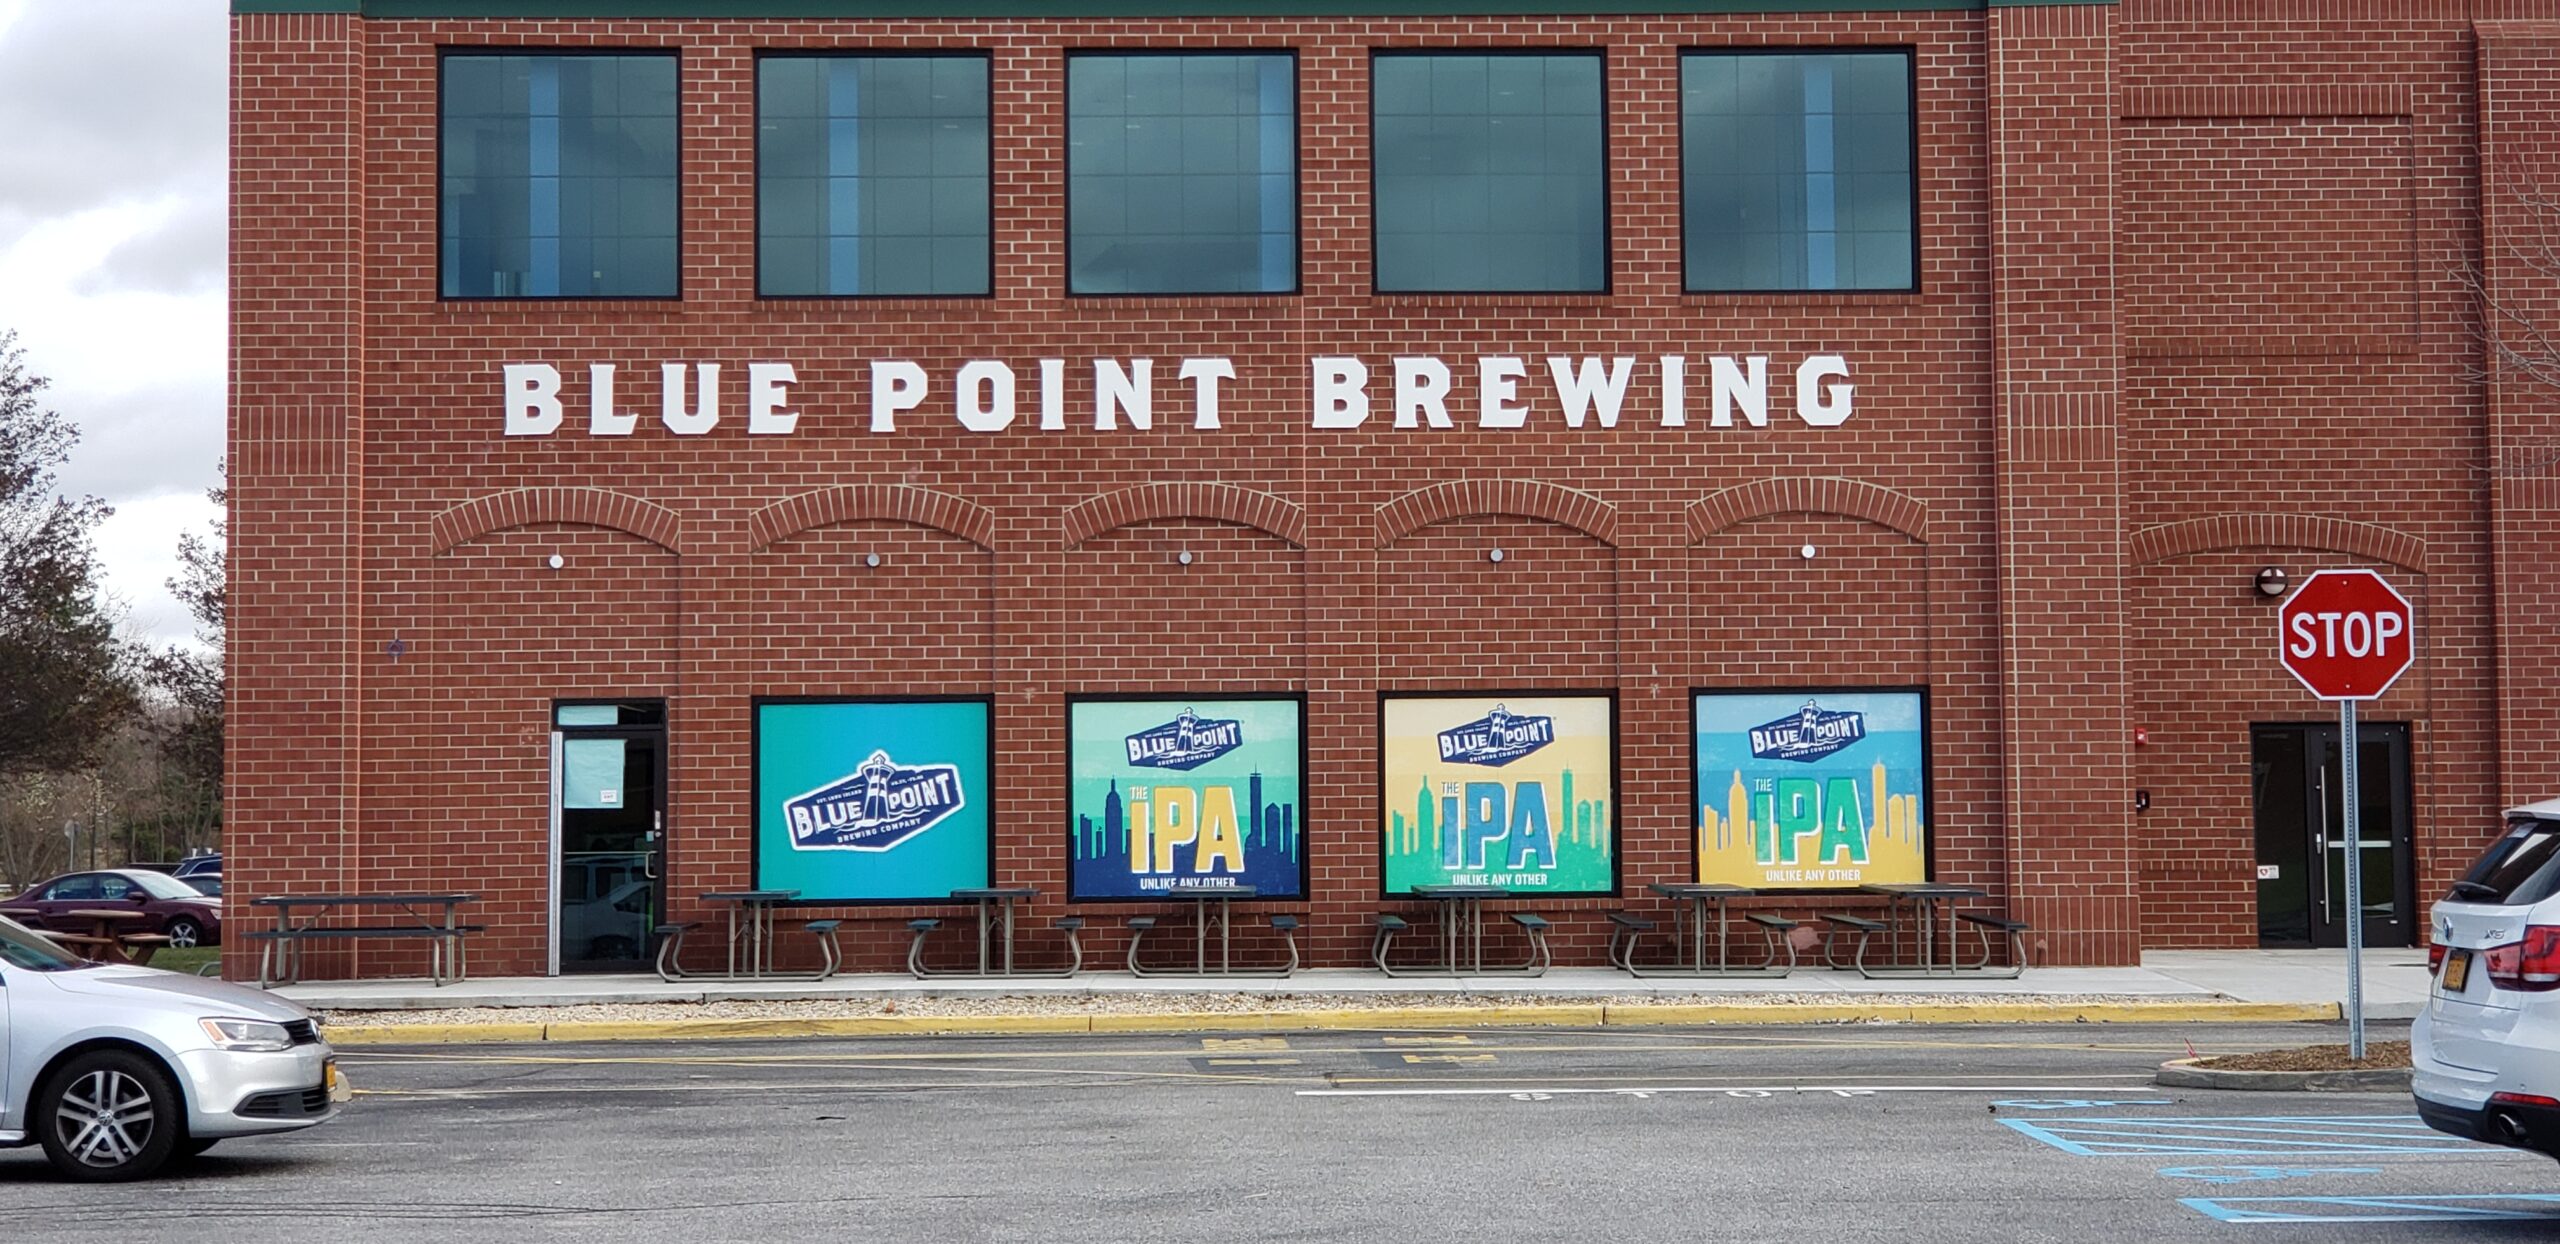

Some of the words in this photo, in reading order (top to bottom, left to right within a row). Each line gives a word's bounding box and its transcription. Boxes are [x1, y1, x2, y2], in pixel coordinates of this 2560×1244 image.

[503, 362, 799, 436] BLUE
[870, 357, 1236, 433] POINT
[1311, 355, 1855, 429] BREWING
[2290, 611, 2403, 659] STOP
[1127, 738, 1176, 762] BLUE
[1193, 722, 1237, 746] POINT
[1440, 734, 1488, 759] BLUE
[1505, 719, 1549, 743] POINT
[1751, 729, 1799, 754] BLUE
[1817, 715, 1860, 738] POINT
[1130, 786, 1148, 800] THE
[1441, 782, 1460, 794] THE
[1754, 778, 1772, 792] THE
[792, 801, 863, 840] BLUE
[888, 772, 952, 810] POINT
[837, 828, 878, 843] BREWING
[880, 817, 921, 833] COMPANY
[1140, 877, 1177, 890] UNLIKE
[1179, 877, 1201, 888] ANY
[1203, 877, 1236, 888] OTHER
[1452, 874, 1489, 886] UNLIKE
[1491, 873, 1512, 885] ANY
[1515, 873, 1548, 885] OTHER
[1766, 870, 1803, 882] UNLIKE
[1804, 870, 1825, 881] ANY
[1828, 869, 1861, 881] OTHER
